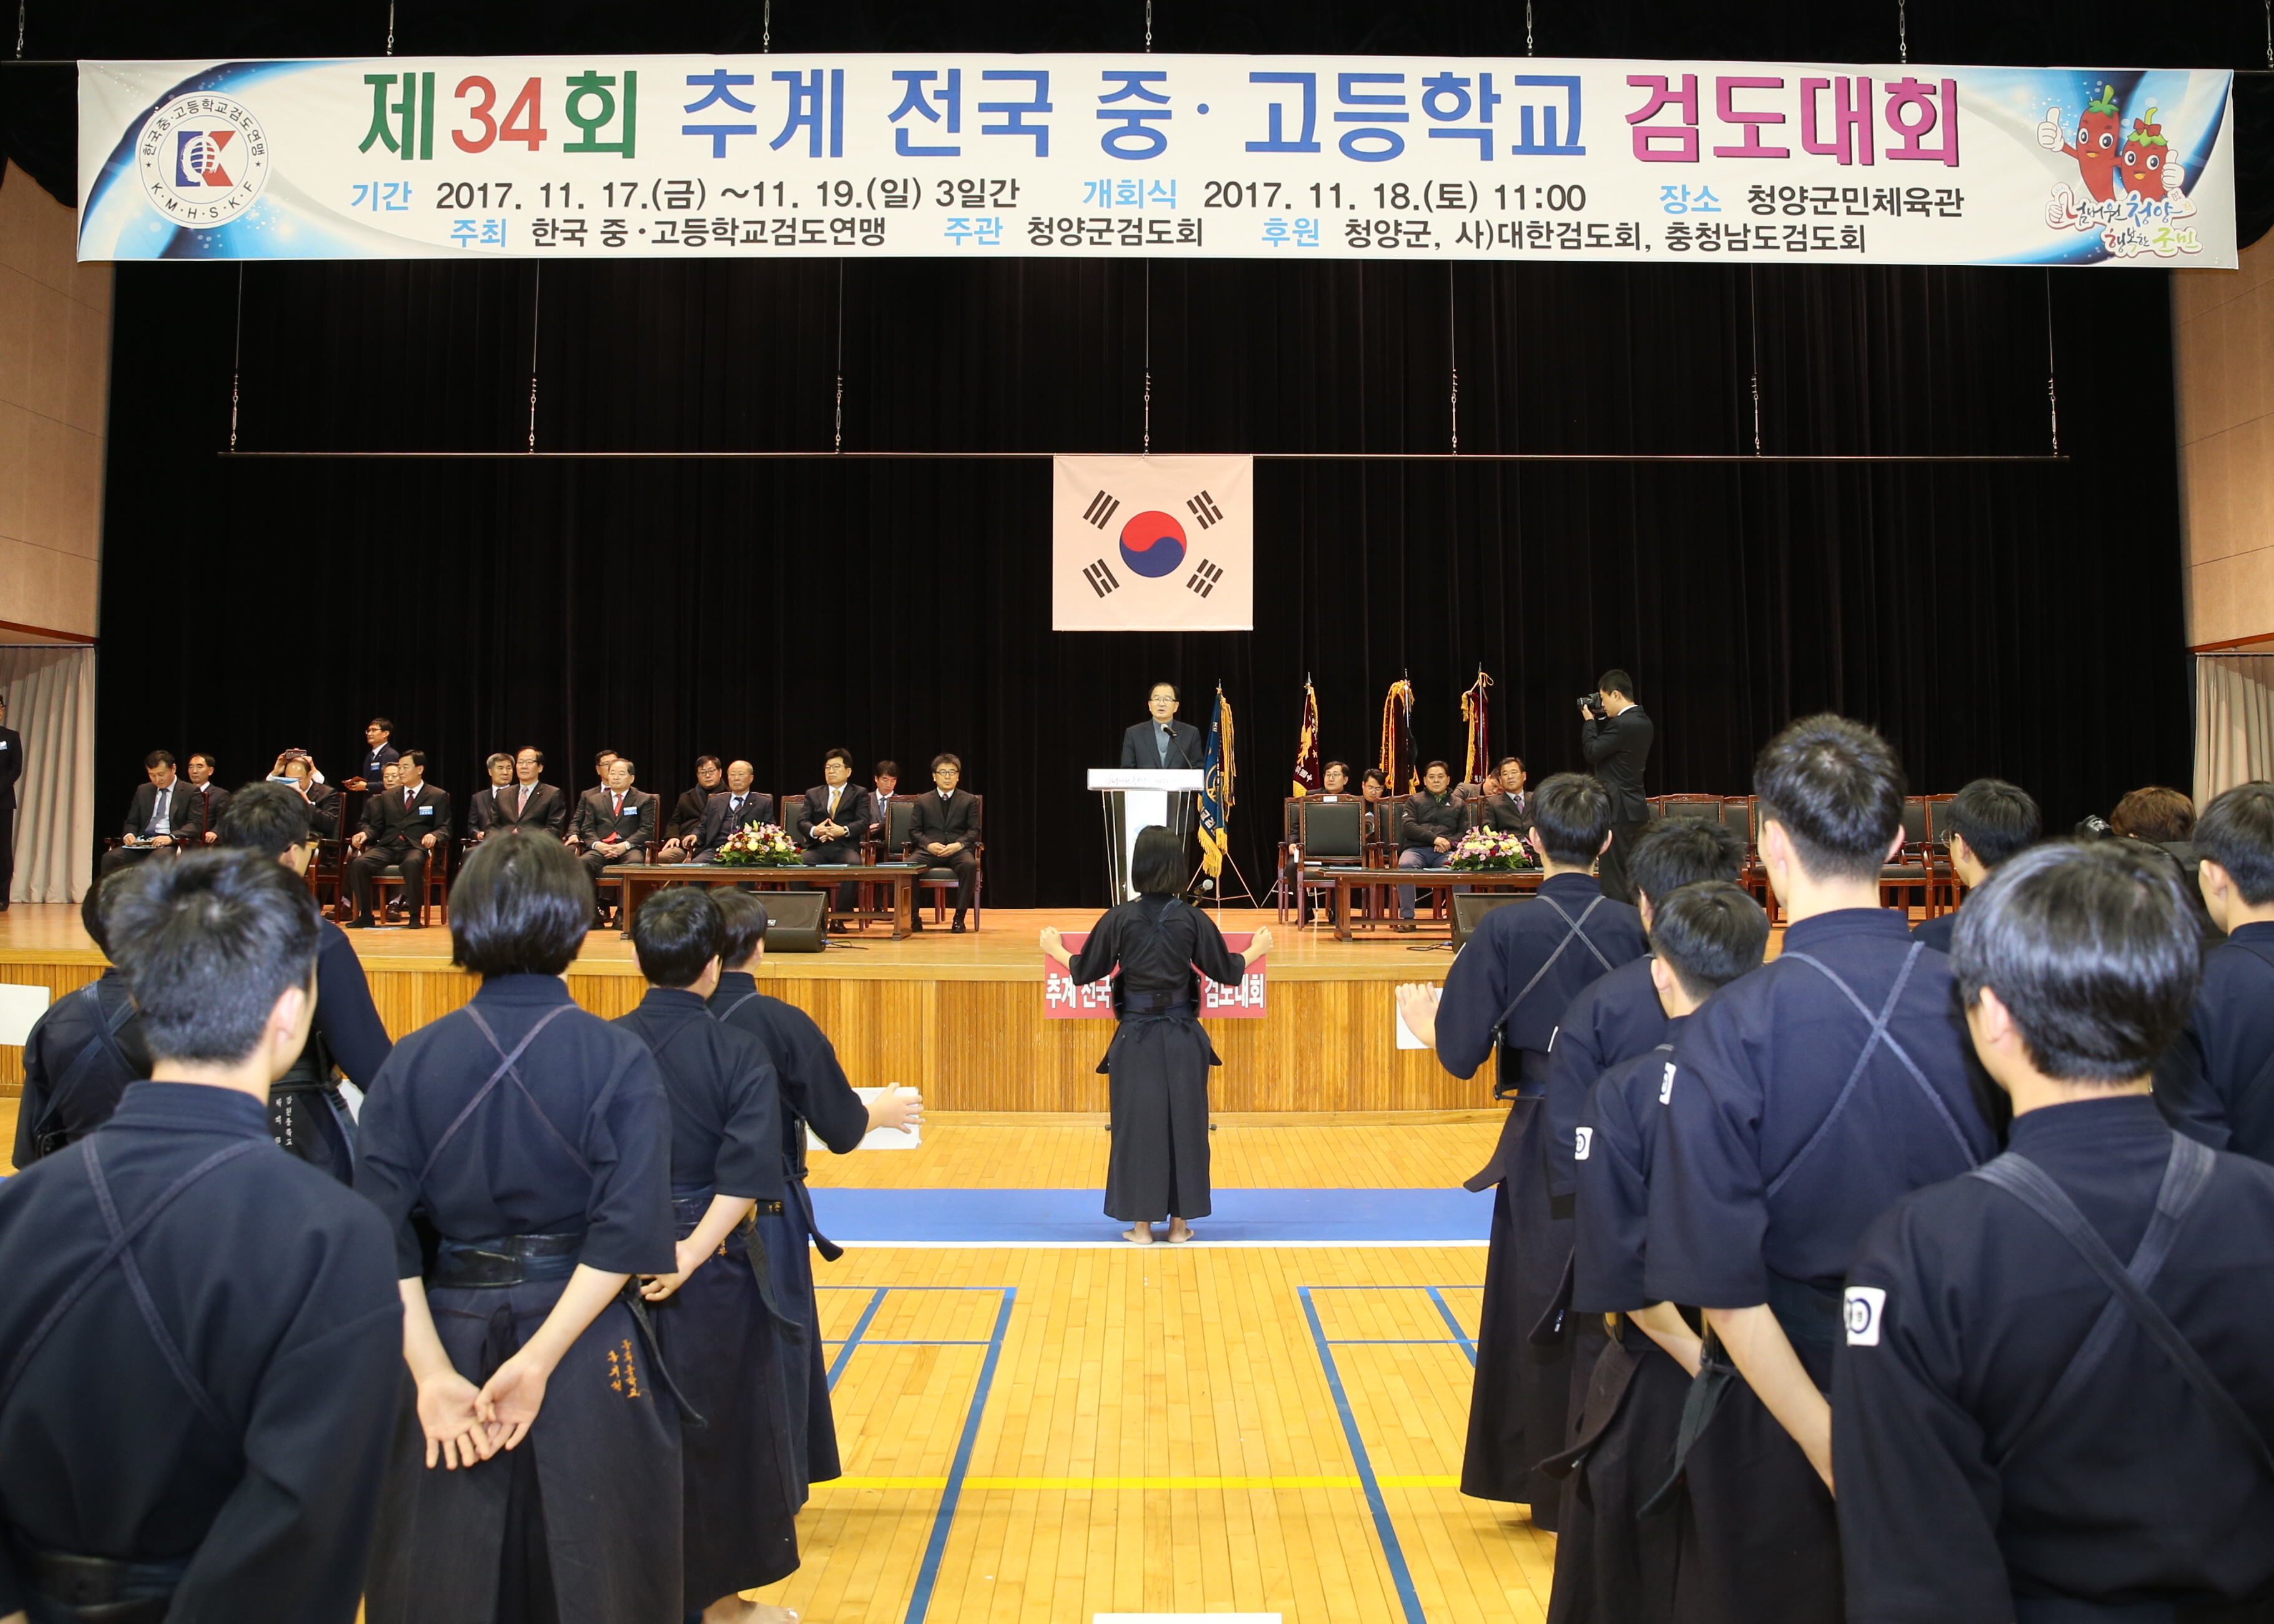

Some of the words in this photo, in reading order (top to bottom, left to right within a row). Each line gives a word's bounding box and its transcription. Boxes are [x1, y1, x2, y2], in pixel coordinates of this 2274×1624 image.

[358, 70, 637, 160] 제34회
[682, 69, 844, 158] 추계
[887, 68, 1053, 158] 전국
[1624, 74, 1959, 167] 검도대회
[351, 182, 412, 212] 기간
[436, 182, 522, 210] 2017.
[540, 182, 584, 210] 11.
[935, 178, 1020, 208] 3일간
[1083, 178, 1177, 210] 개회식
[1204, 180, 1292, 210] 2017.
[1310, 182, 1355, 210] 11.
[1495, 185, 1586, 212] 11:00
[1659, 184, 1722, 215] 장소
[1747, 185, 1964, 218] 청양군민체육관
[450, 219, 506, 247] 주최
[532, 218, 588, 248] 한국
[944, 216, 1003, 246] 주관
[1027, 216, 1203, 247] 청양군검도회
[1261, 218, 1320, 247] 후원
[1344, 218, 1440, 251] 청양군,
[1664, 221, 1865, 253] 충청남도검도회
[1045, 973, 1076, 1009] 추계
